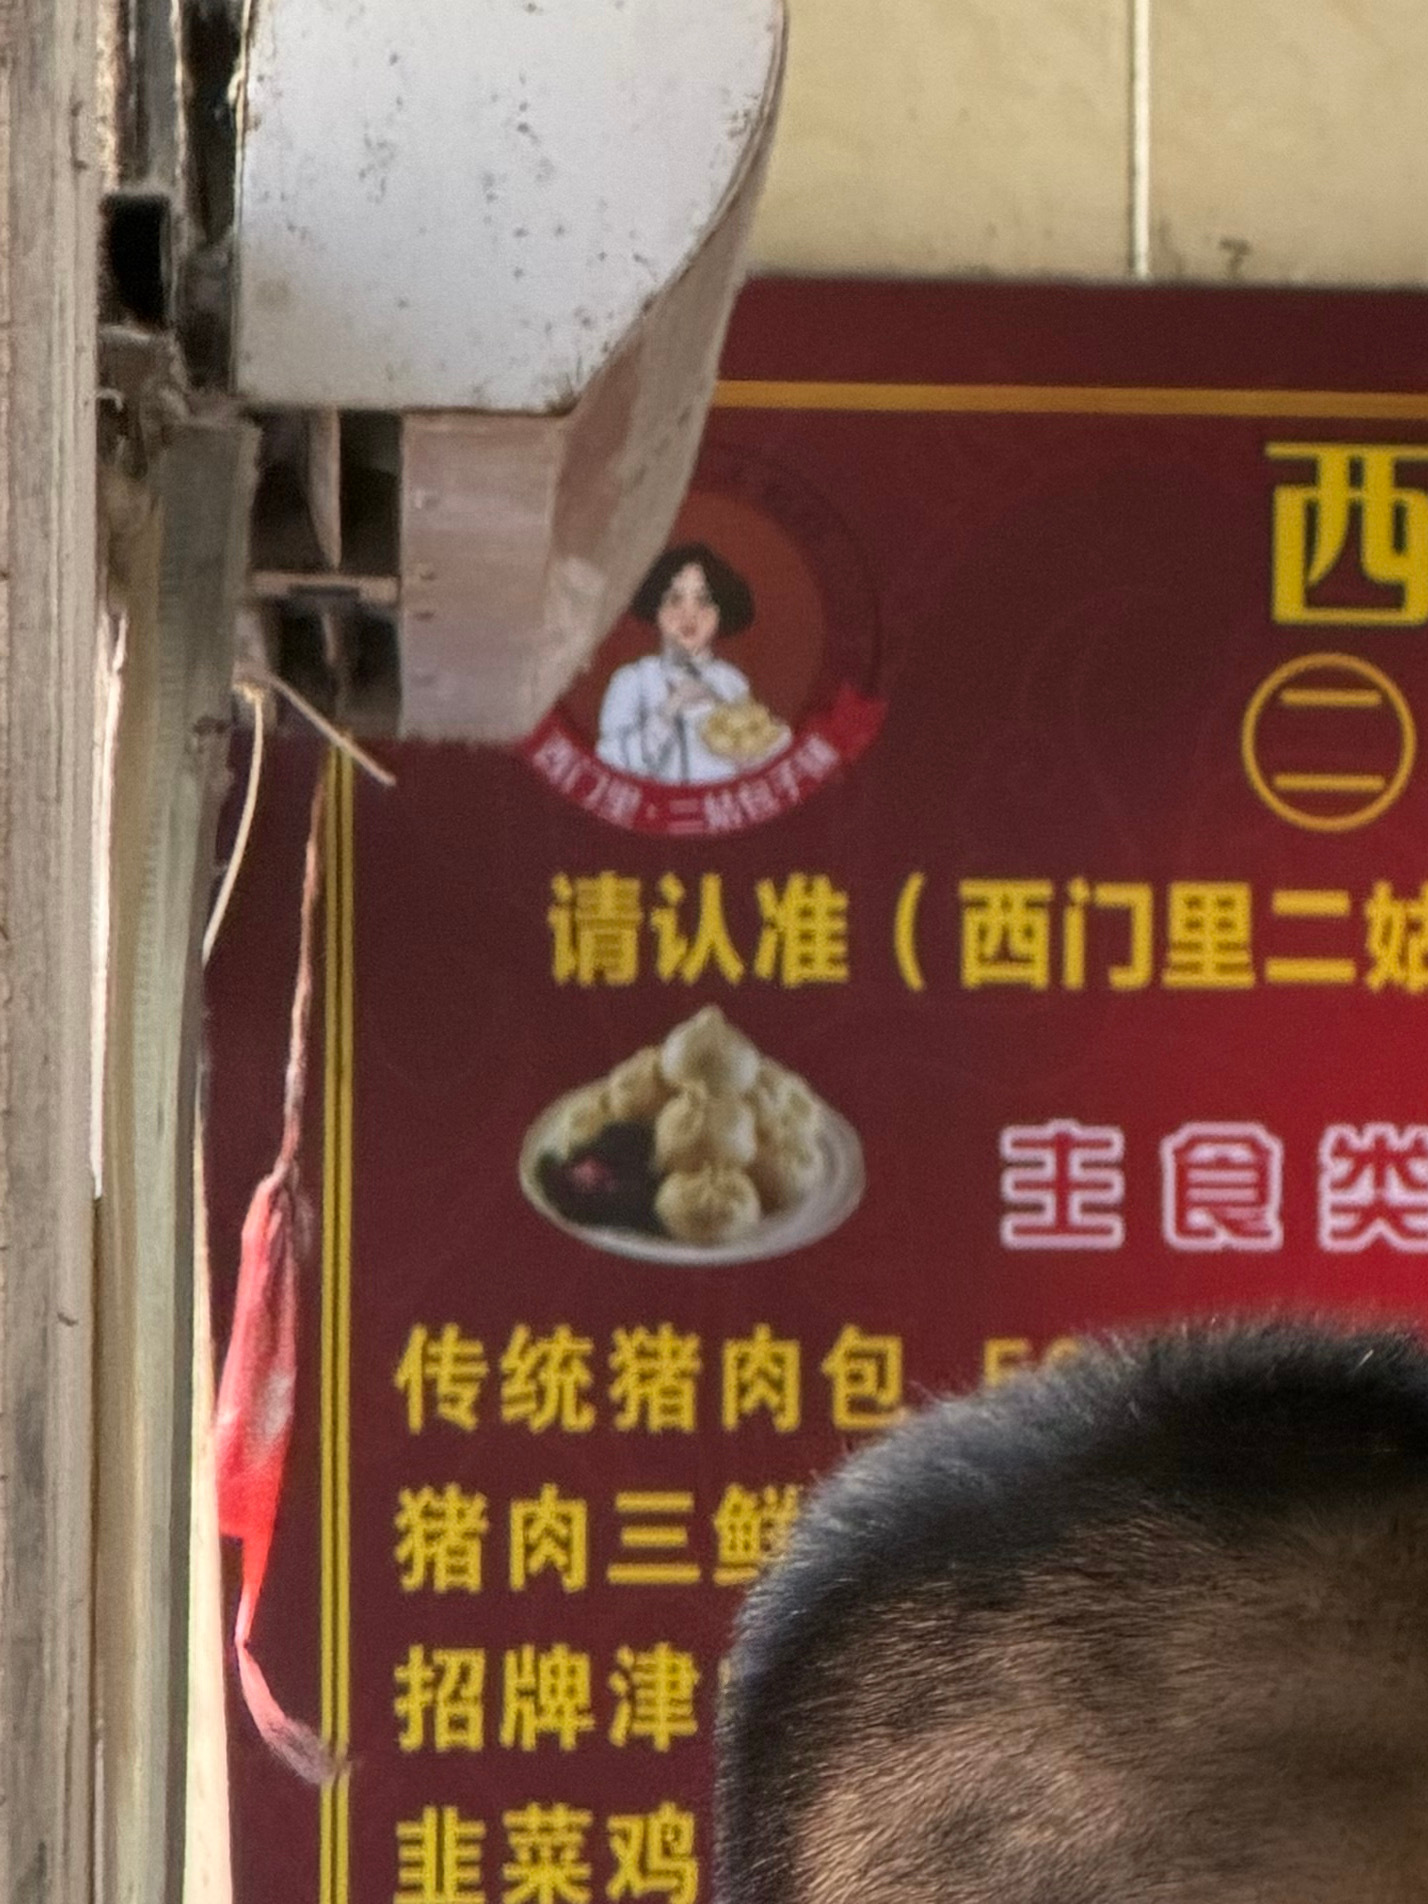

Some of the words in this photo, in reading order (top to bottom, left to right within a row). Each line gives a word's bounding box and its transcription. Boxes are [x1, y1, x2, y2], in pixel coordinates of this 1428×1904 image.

[394, 1323, 909, 1435] 传统猪肉包
[393, 1643, 735, 1753] 招牌津
